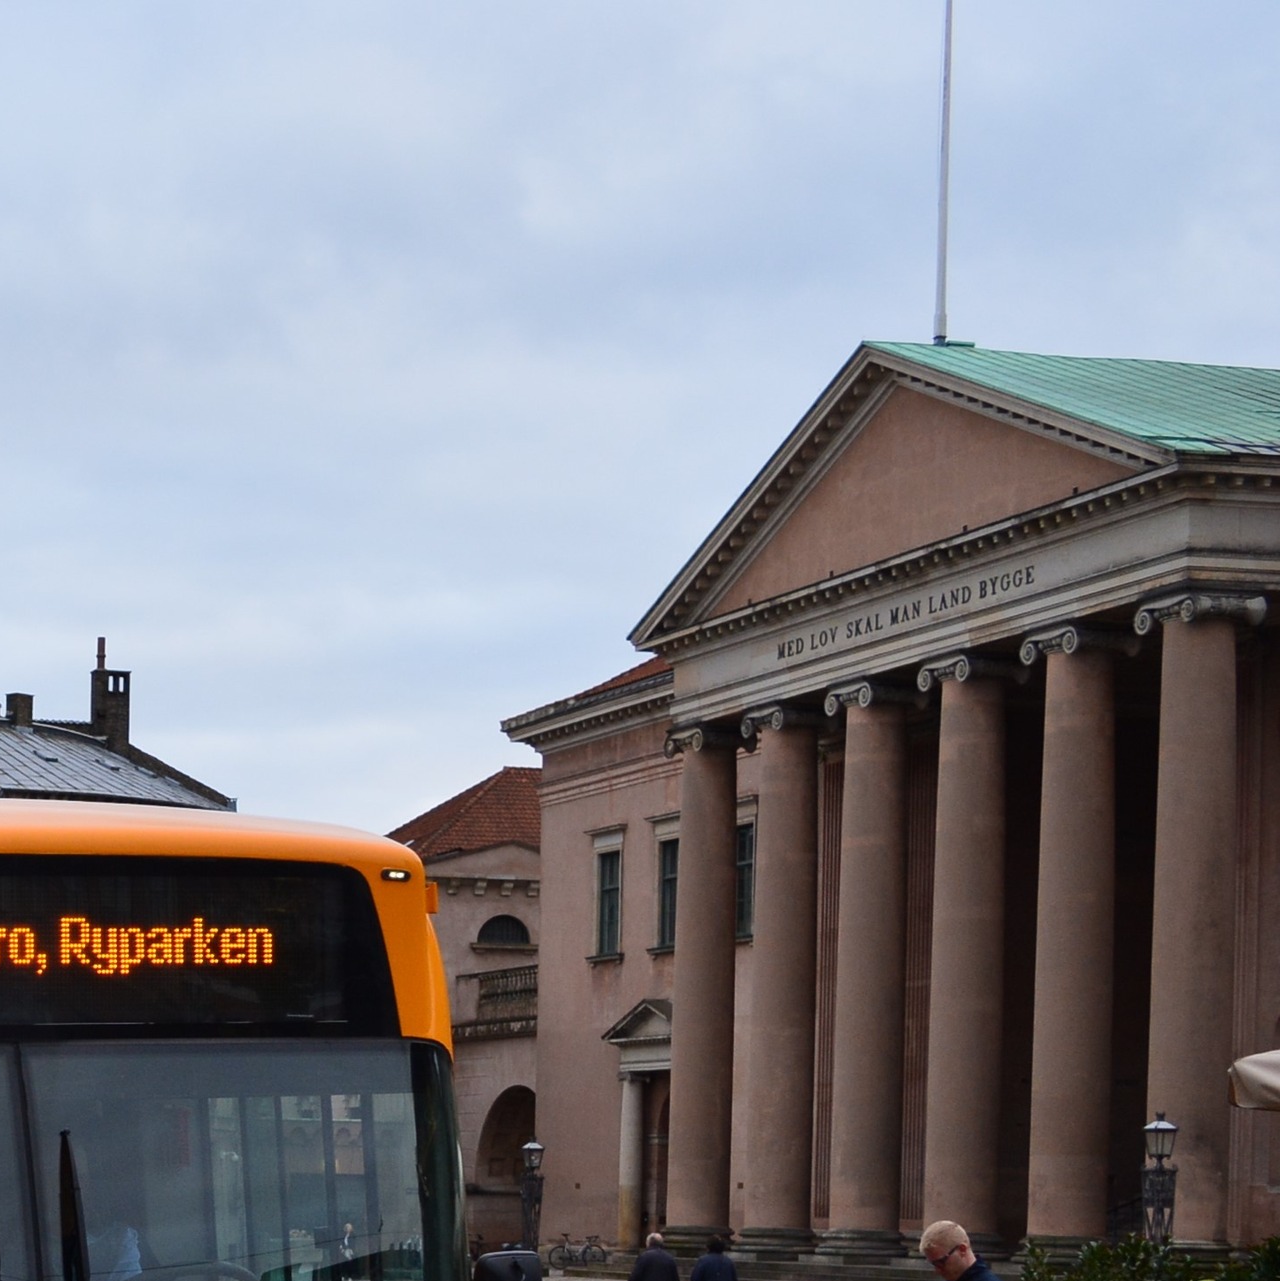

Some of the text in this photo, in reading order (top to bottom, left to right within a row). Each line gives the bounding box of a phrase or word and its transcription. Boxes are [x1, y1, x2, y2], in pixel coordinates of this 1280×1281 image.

[777, 565, 1035, 660] MED LOV SKAL MAN LAND BYGGE
[60, 917, 273, 975] Ryparken
